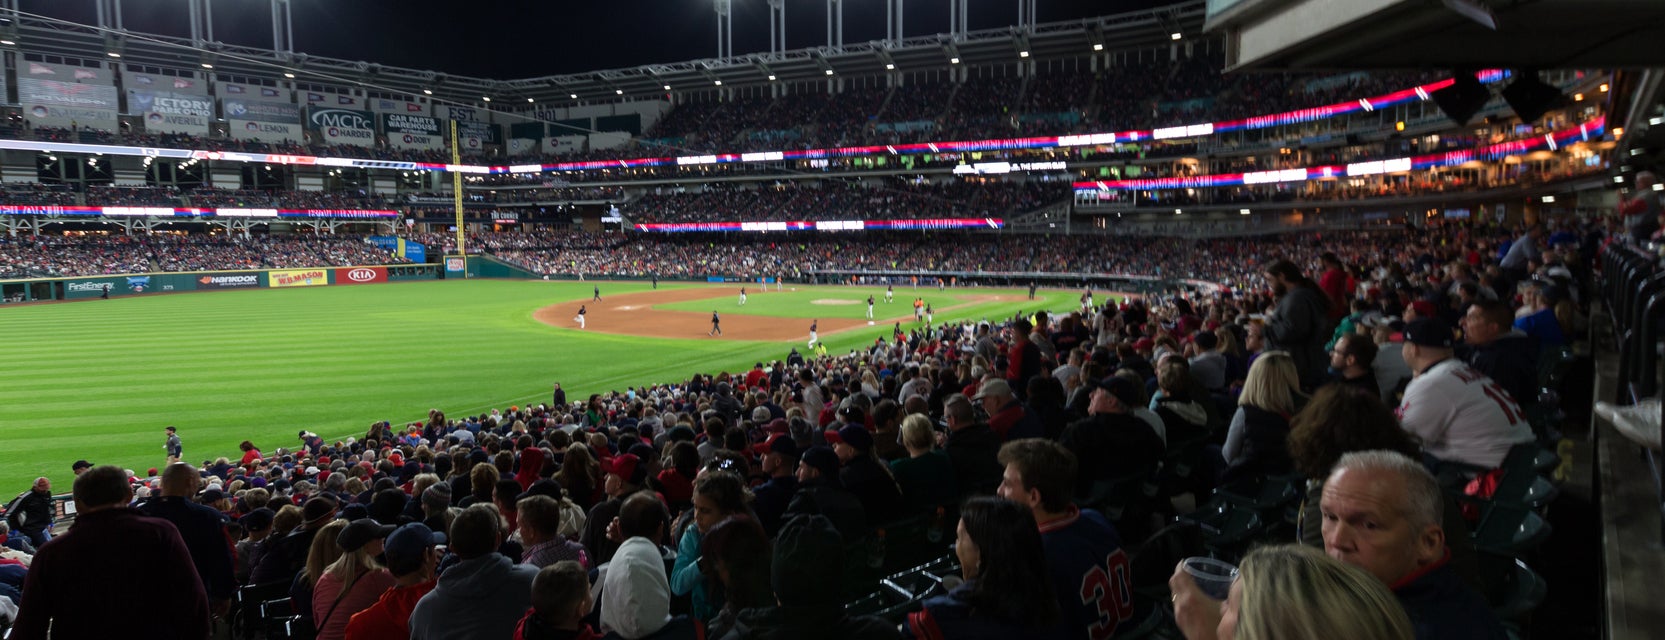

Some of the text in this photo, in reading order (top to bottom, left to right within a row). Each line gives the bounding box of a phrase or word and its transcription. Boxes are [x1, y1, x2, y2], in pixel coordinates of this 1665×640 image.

[152, 105, 182, 115] PARK
[449, 107, 479, 121] EST.
[165, 115, 205, 127] AVERILL
[389, 114, 436, 125] CAR PARTS
[258, 124, 289, 134] LEMON
[387, 120, 438, 132] WAREHOUSE
[340, 129, 372, 139] HARDER
[353, 270, 372, 279] KIA
[68, 281, 115, 291] FirstEnergy
[1080, 548, 1134, 640] 30
